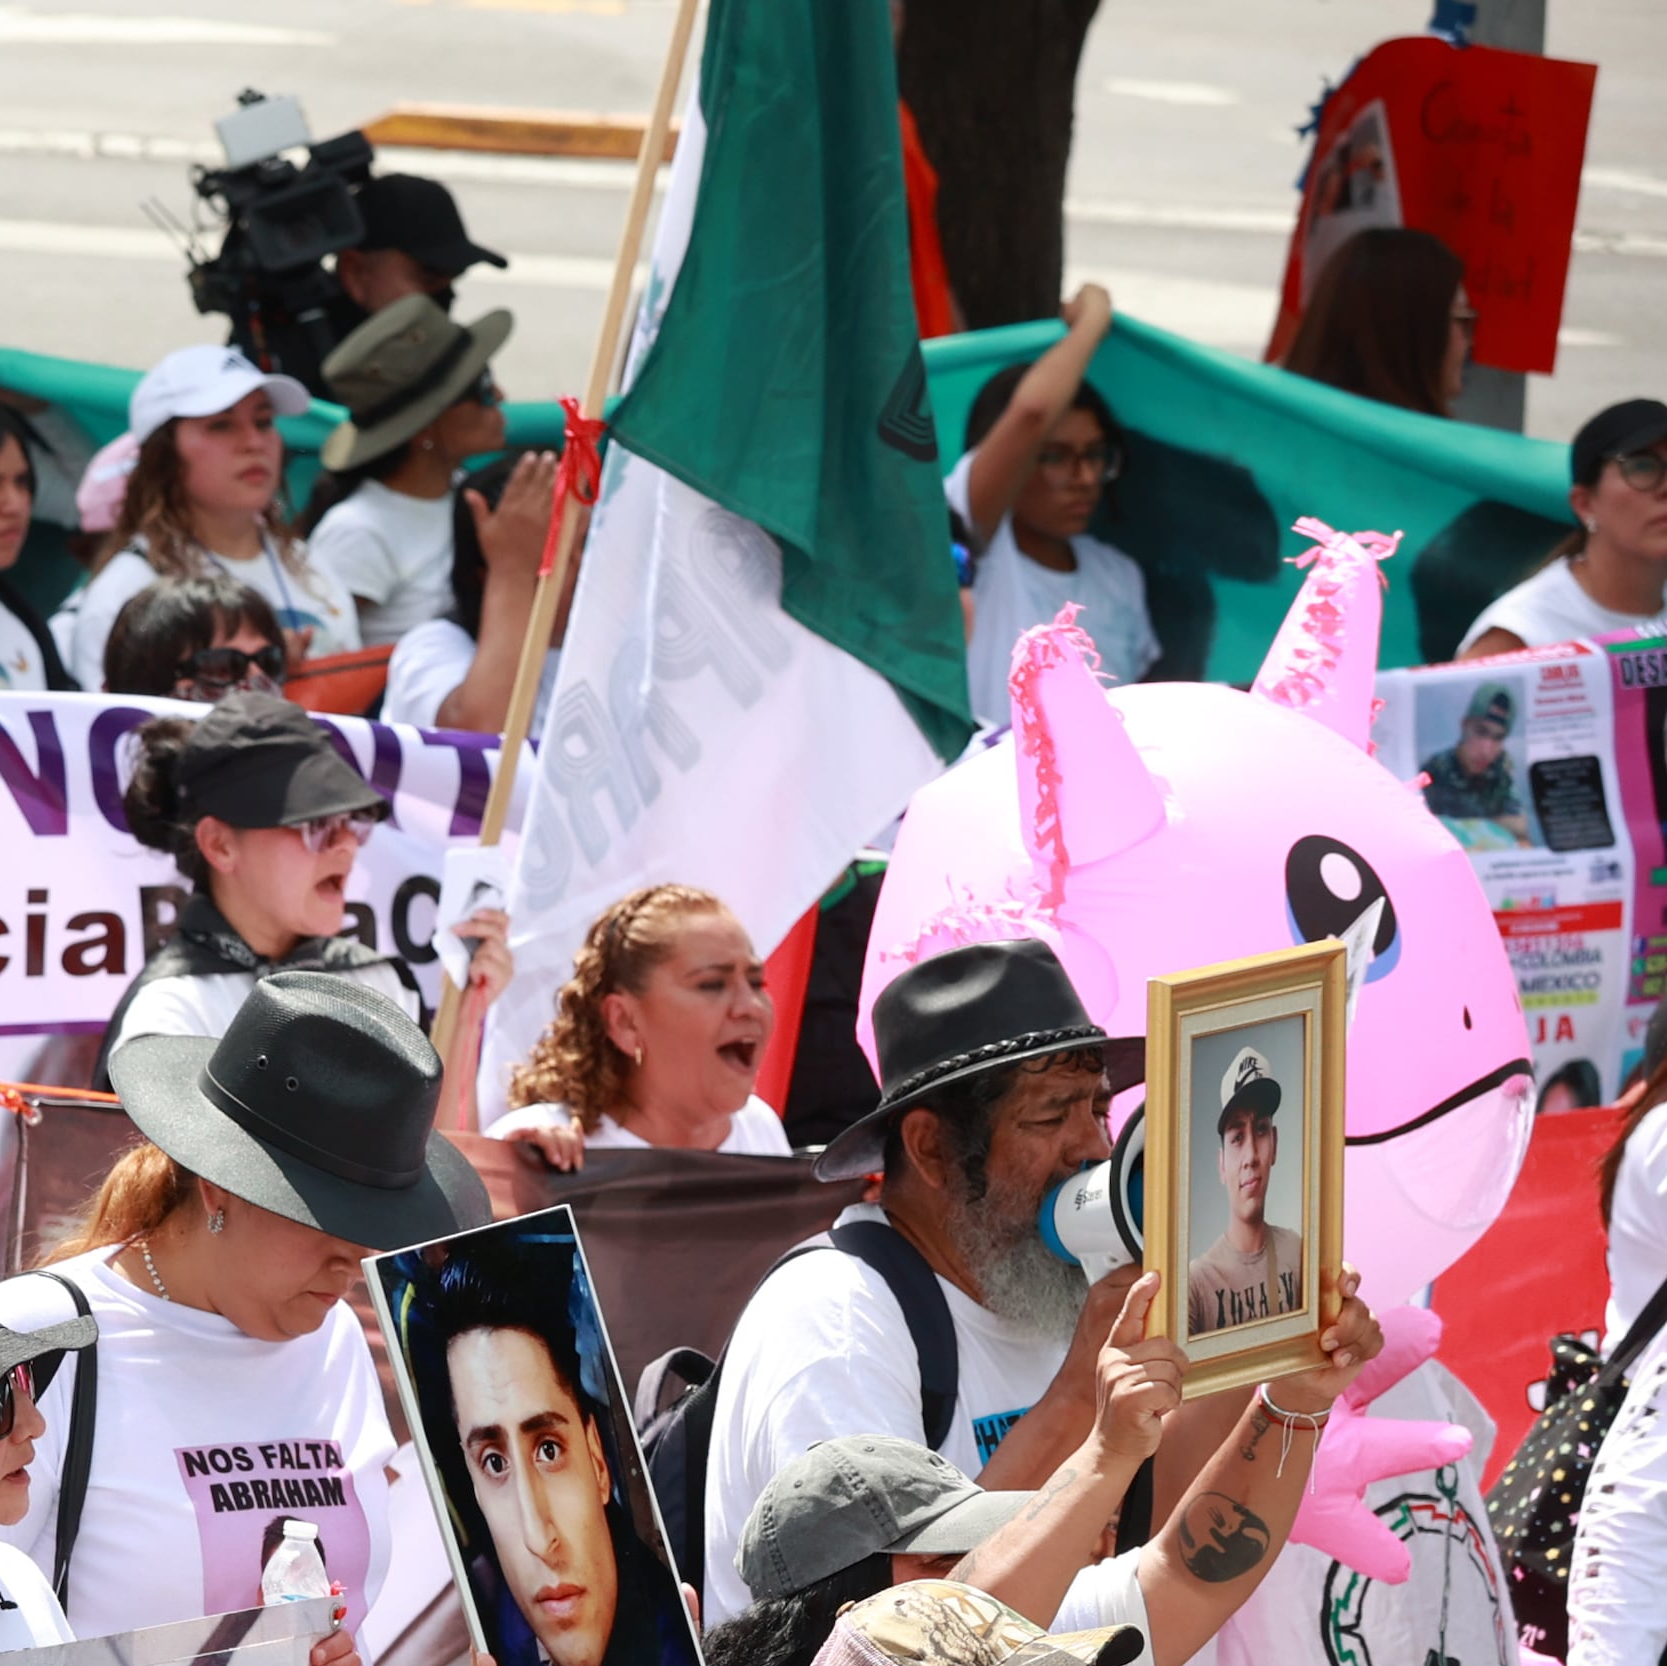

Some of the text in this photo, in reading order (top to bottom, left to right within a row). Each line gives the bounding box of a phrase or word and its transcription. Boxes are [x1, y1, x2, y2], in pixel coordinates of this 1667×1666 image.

[183, 1439, 345, 1477] NOS FALTA
[209, 1476, 348, 1514] ABRAHAM
